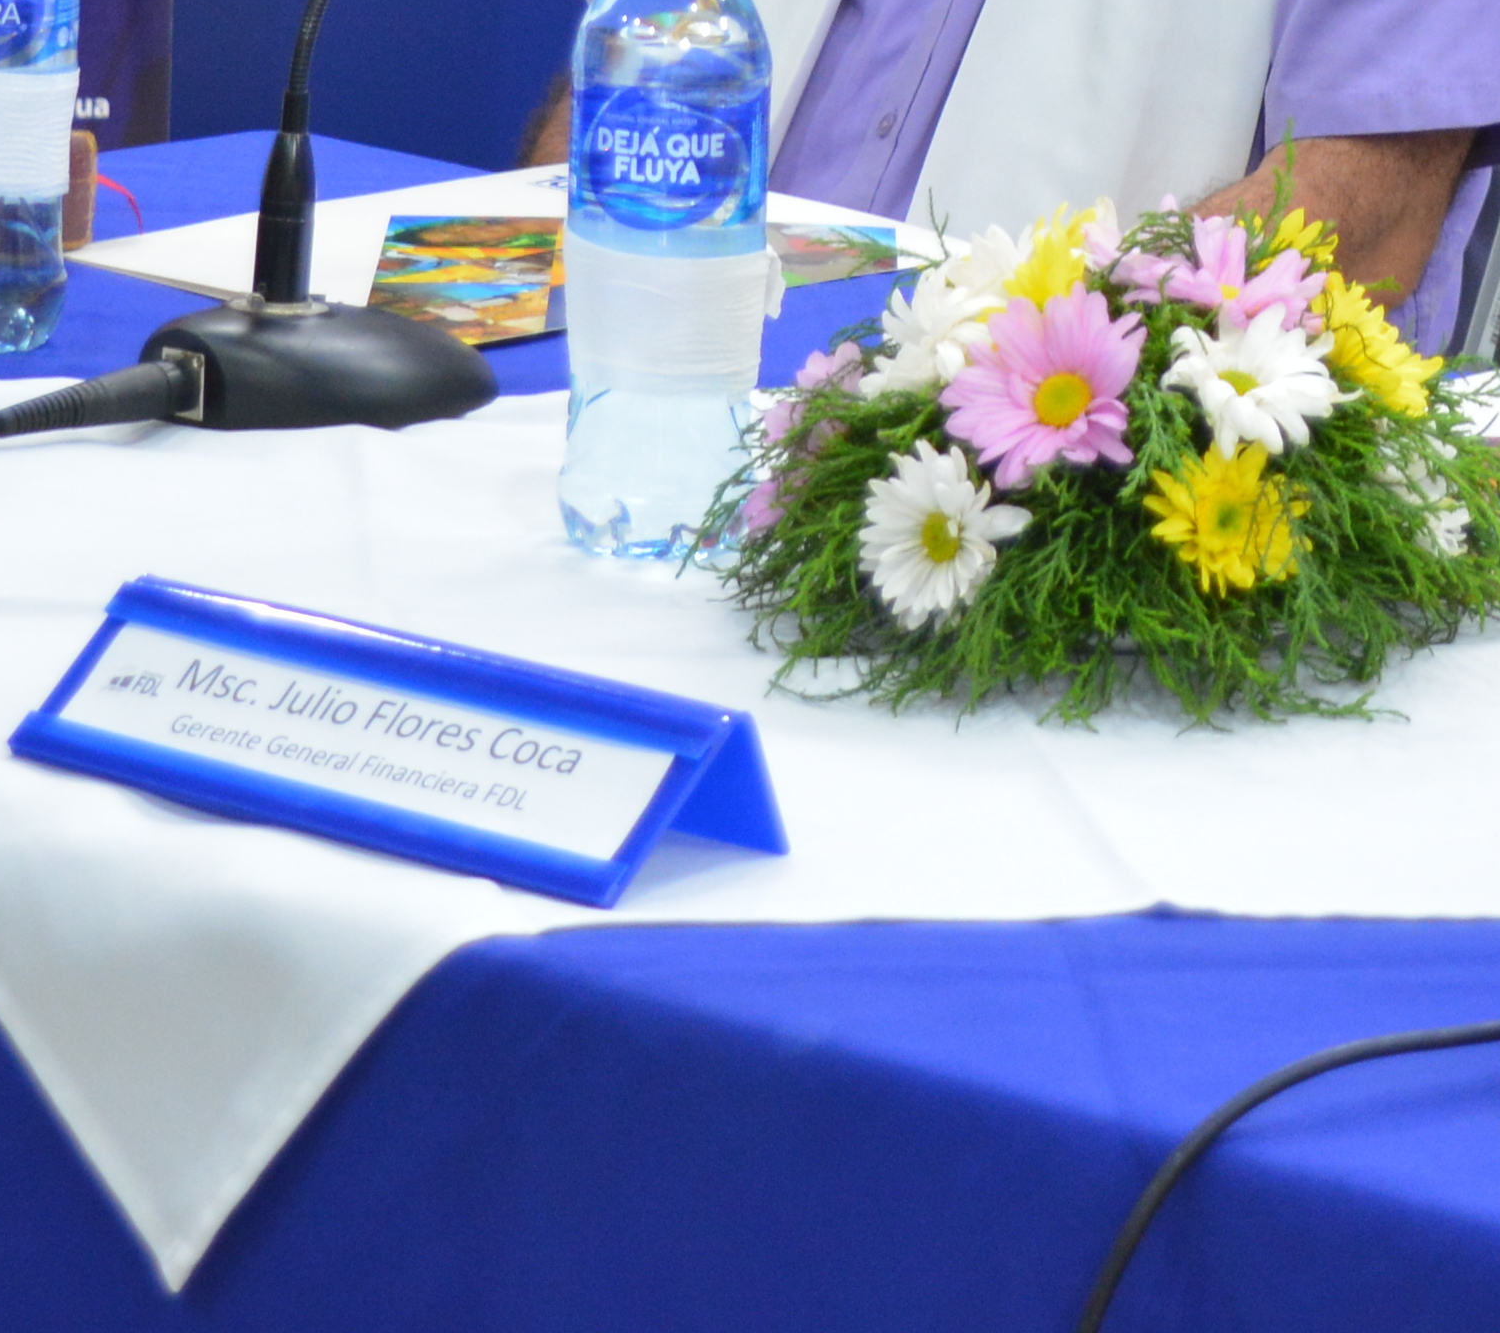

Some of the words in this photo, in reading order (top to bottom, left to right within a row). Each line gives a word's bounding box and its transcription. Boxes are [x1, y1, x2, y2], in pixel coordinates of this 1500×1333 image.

[597, 125, 660, 158] DEJÁ
[666, 133, 726, 159] QUE
[615, 155, 700, 185] FLUYA
[130, 673, 165, 698] FDL
[175, 657, 258, 707] Msc.
[268, 683, 360, 728] Julio
[363, 698, 479, 755] Flores
[487, 726, 584, 777] Coca
[170, 713, 264, 752] Gerente
[266, 731, 361, 774] General
[357, 753, 481, 802] Financiera
[481, 783, 528, 813] FDL
